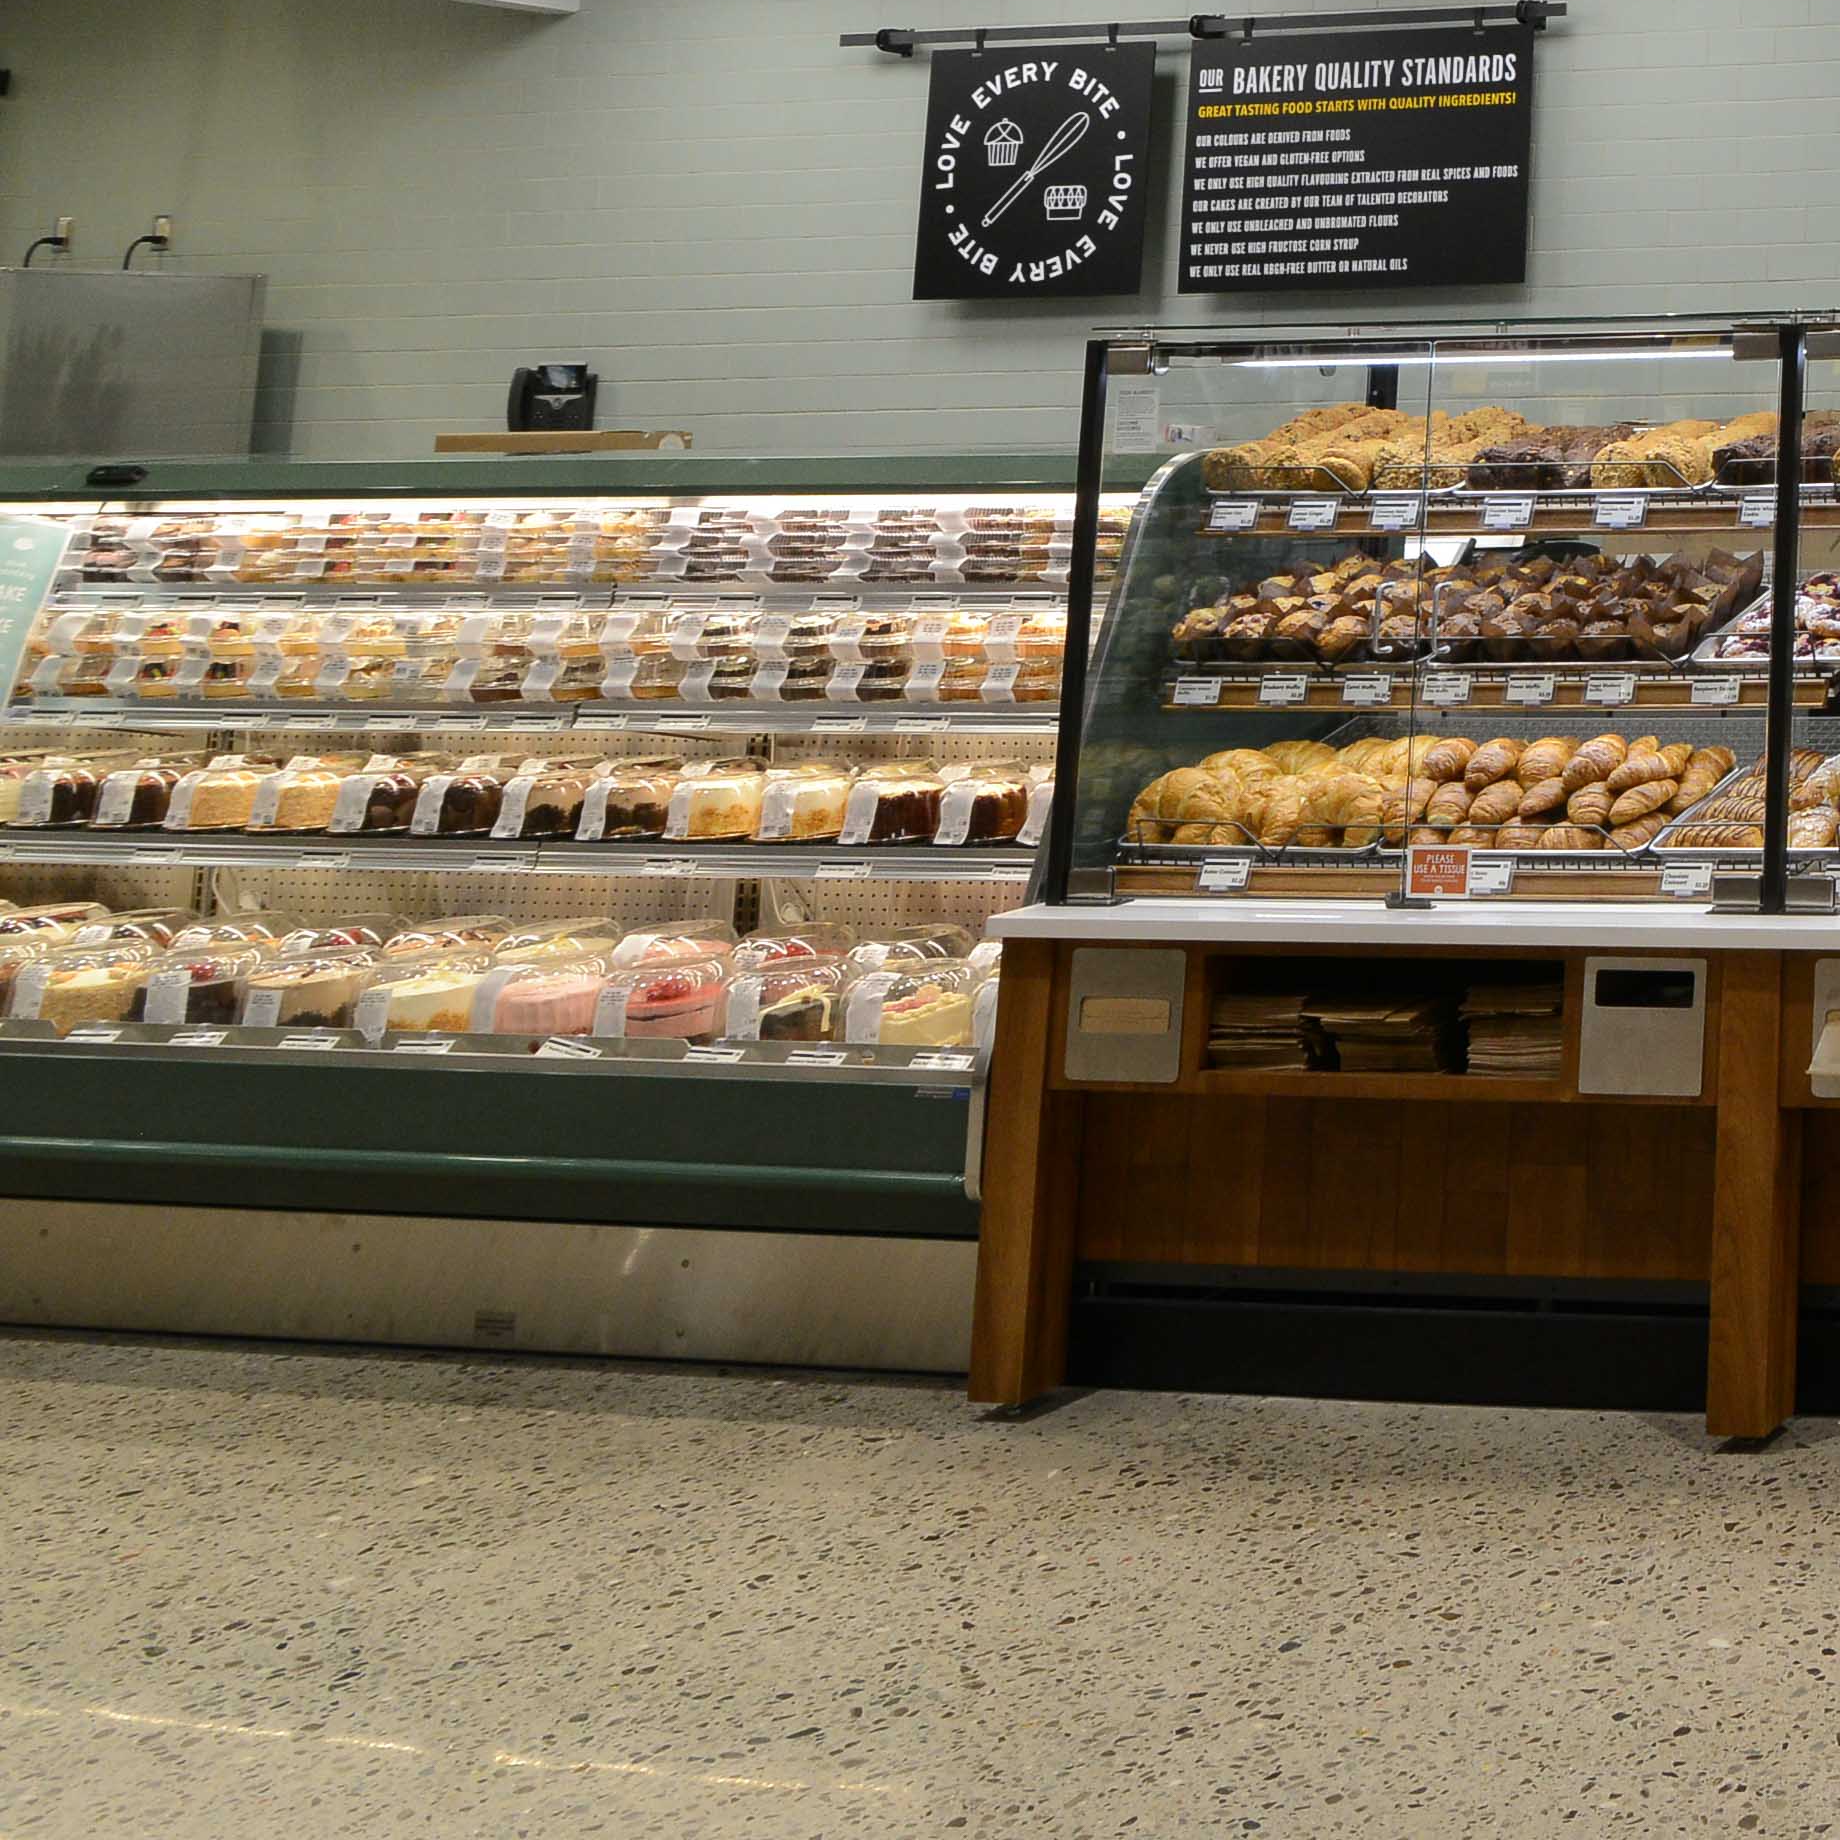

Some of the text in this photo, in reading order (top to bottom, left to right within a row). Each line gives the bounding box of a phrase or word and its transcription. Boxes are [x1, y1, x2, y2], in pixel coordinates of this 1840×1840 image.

[1199, 53, 1517, 94] OUR BAKERY QUALITY STANDARDS
[1198, 92, 1516, 118] GREAT TASTING FOOD STARTS WITH QUALITY INGREDIENTS!
[936, 61, 1120, 190] LOVE EVERY BITE
[1196, 129, 1351, 147] OUR COLOURS ARE DERIVED FROM FOODS
[1195, 151, 1365, 168] WE OFFER VEGAN AND GLUTEN-FREE OPTIONS
[1194, 165, 1518, 190] WE ONLY USE HIGH QUALITY FLAVOURING EXTRACTED FROM REAL SPICES AND FOODS
[1193, 190, 1448, 212] OUR CAKES ARE CREATED BY OUR TEAM OF TALENTED DECORATORS
[948, 154, 1134, 283] LOVE EVERY BITE
[1192, 214, 1398, 234] WE ONLY USE UNBLEACHED AND UNBROMATED FLOURS
[1191, 238, 1359, 256] WE NEVER USE HIGH FRUCTOSE CORN SYRUP
[1189, 258, 1408, 278] WE ONLY USE REAL BUTTER OR NATURAL OILS
[1414, 864, 1465, 874] USE A TISSUE
[1426, 854, 1454, 864] PLEASE
